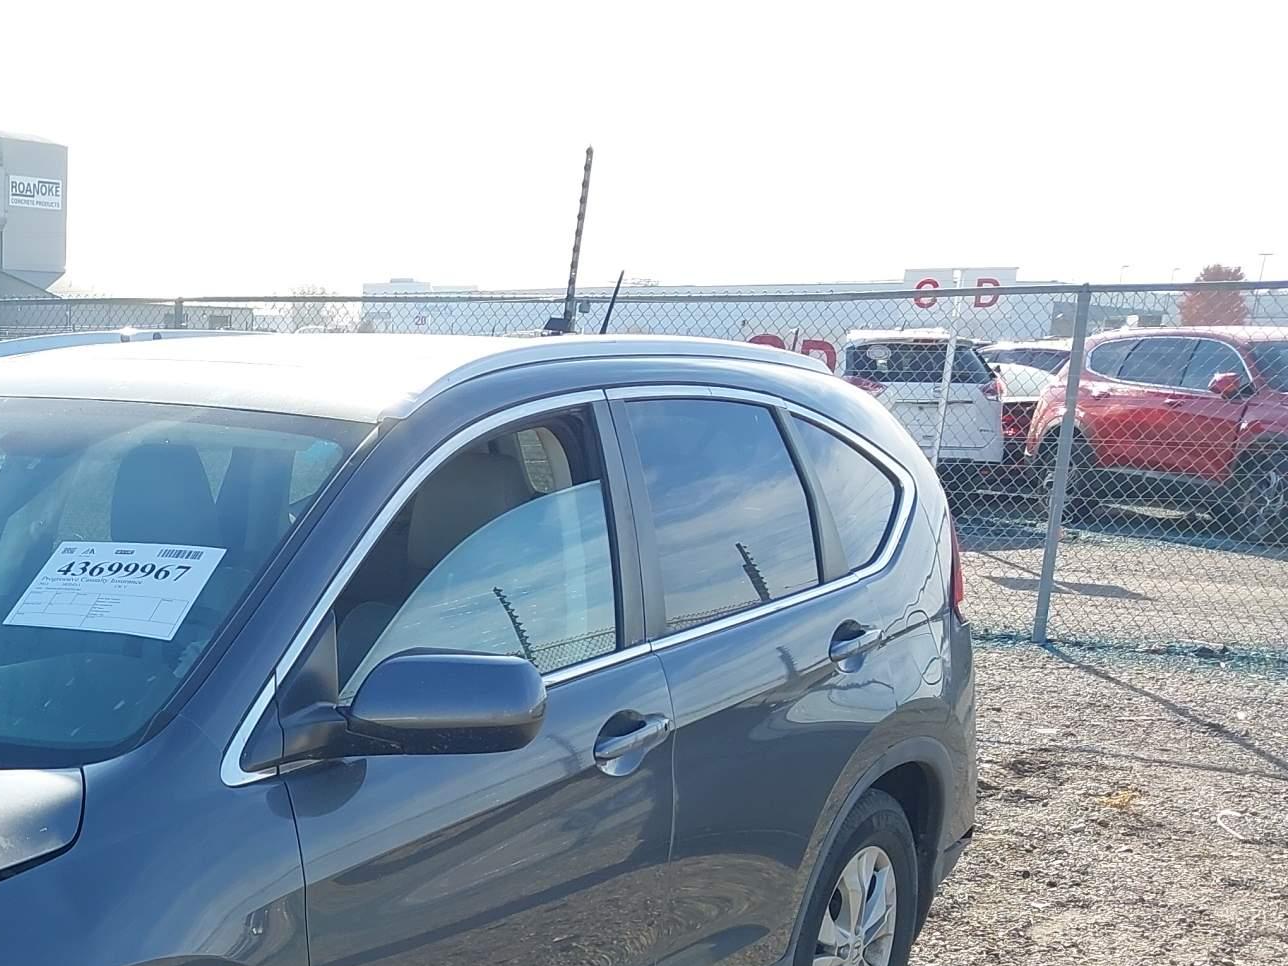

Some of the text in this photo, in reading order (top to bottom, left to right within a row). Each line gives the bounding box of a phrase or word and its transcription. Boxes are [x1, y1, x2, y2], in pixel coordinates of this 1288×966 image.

[11, 181, 60, 197] ROANOKE
[11, 198, 34, 206] CONCRETE
[914, 278, 1000, 308] C D
[56, 561, 192, 581] 43699967
